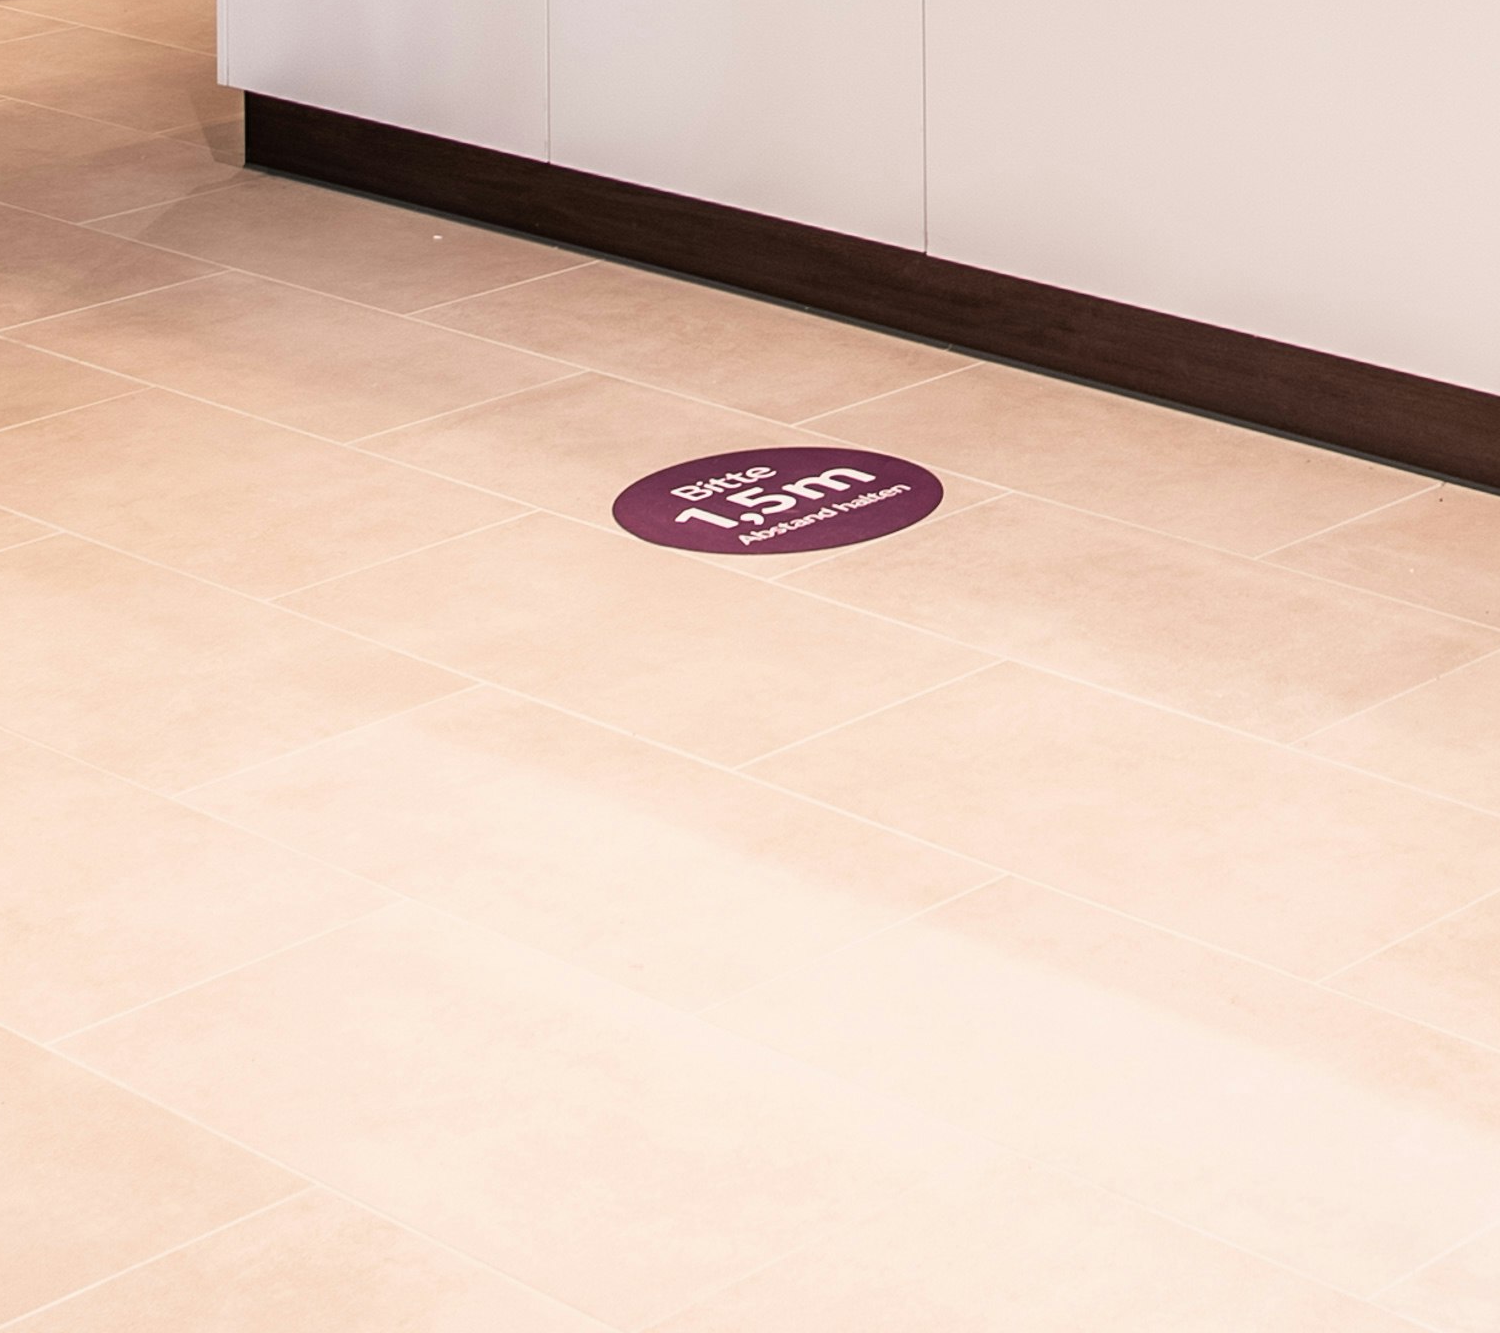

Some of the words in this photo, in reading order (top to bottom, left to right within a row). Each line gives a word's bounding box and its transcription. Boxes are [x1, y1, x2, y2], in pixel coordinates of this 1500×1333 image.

[671, 466, 777, 501] Bitte
[675, 467, 876, 529] 1,5m
[738, 504, 837, 546] Abstand
[836, 483, 911, 515] halten
